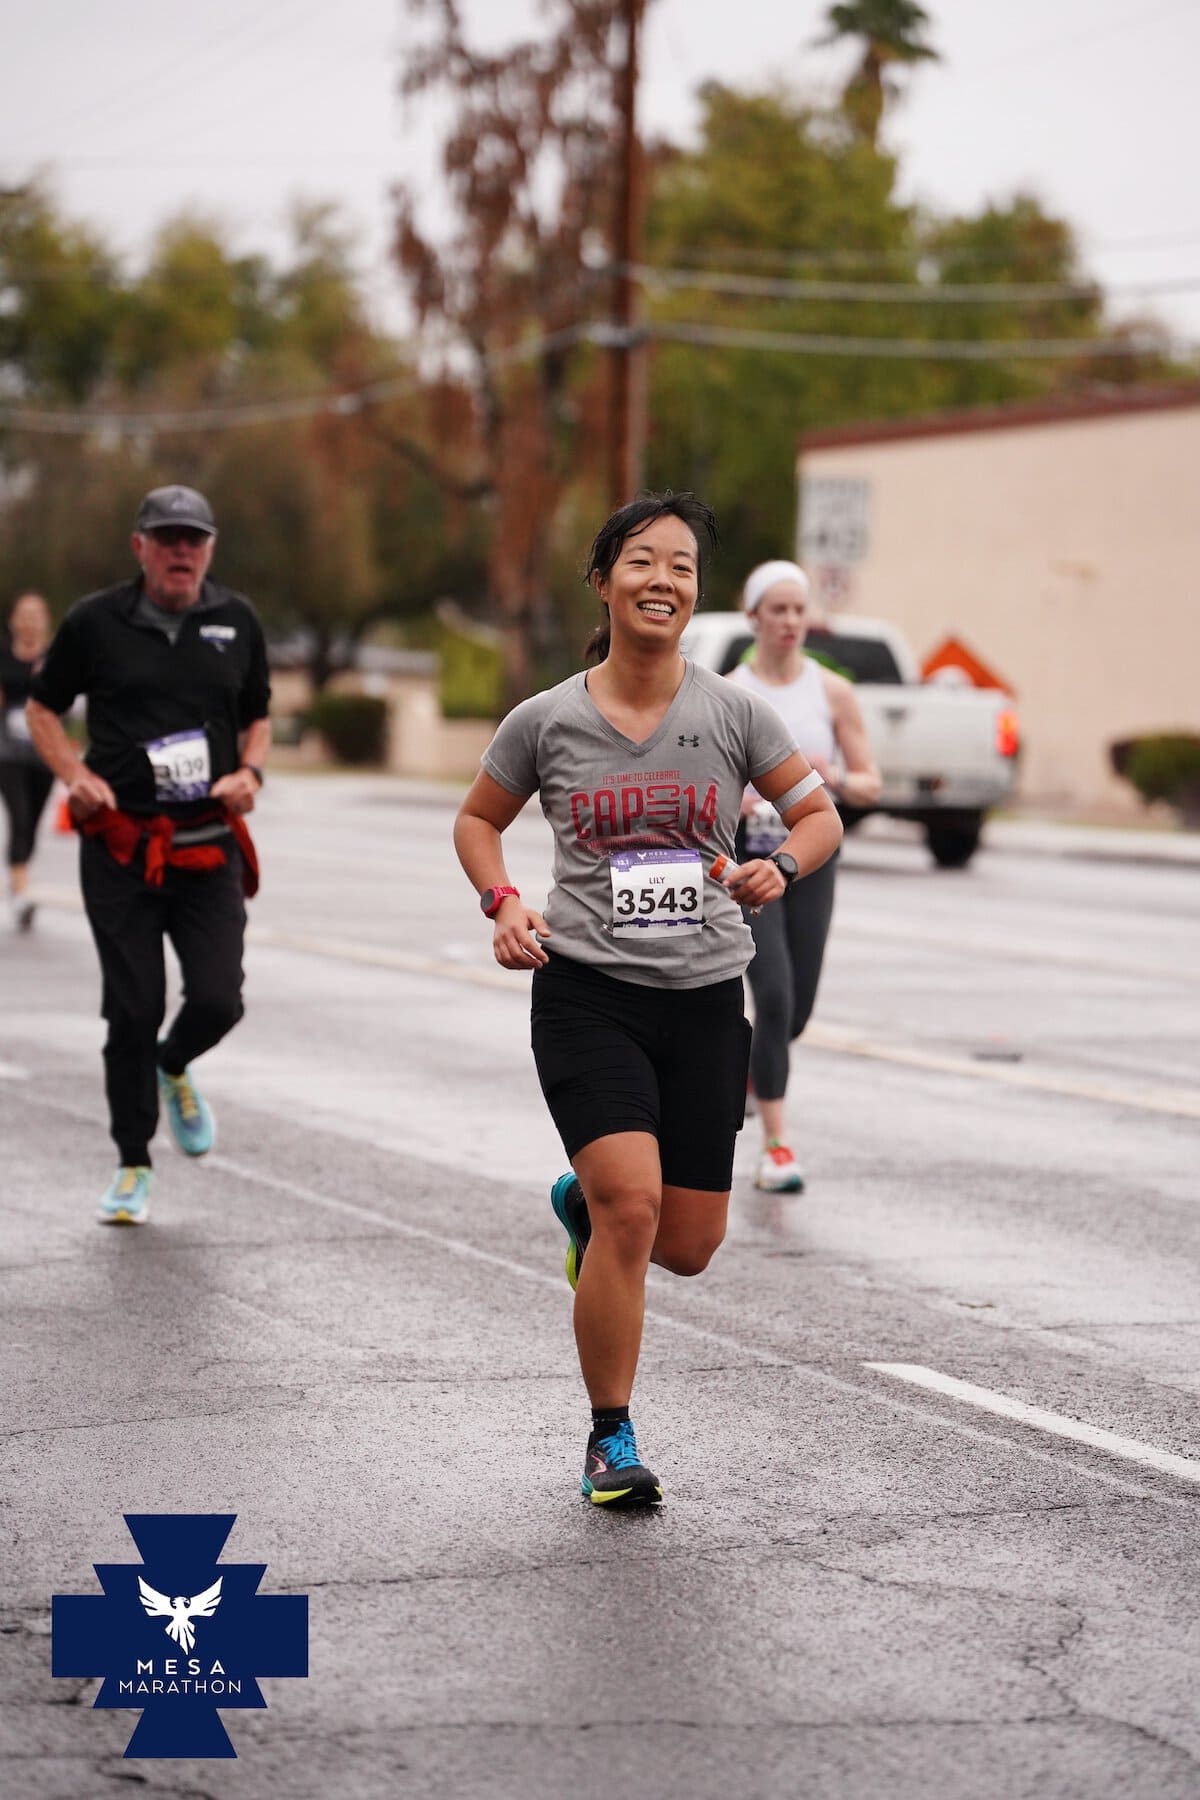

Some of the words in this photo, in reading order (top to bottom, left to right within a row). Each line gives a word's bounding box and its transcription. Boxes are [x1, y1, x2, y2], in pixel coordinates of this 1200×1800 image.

[602, 775, 616, 785] IT'S
[644, 769, 681, 782] CELEBRATE
[570, 785, 644, 840] CAP
[646, 784, 681, 830] CITY
[682, 783, 718, 833] 14
[649, 876, 666, 885] LILY
[616, 886, 699, 916] 3543
